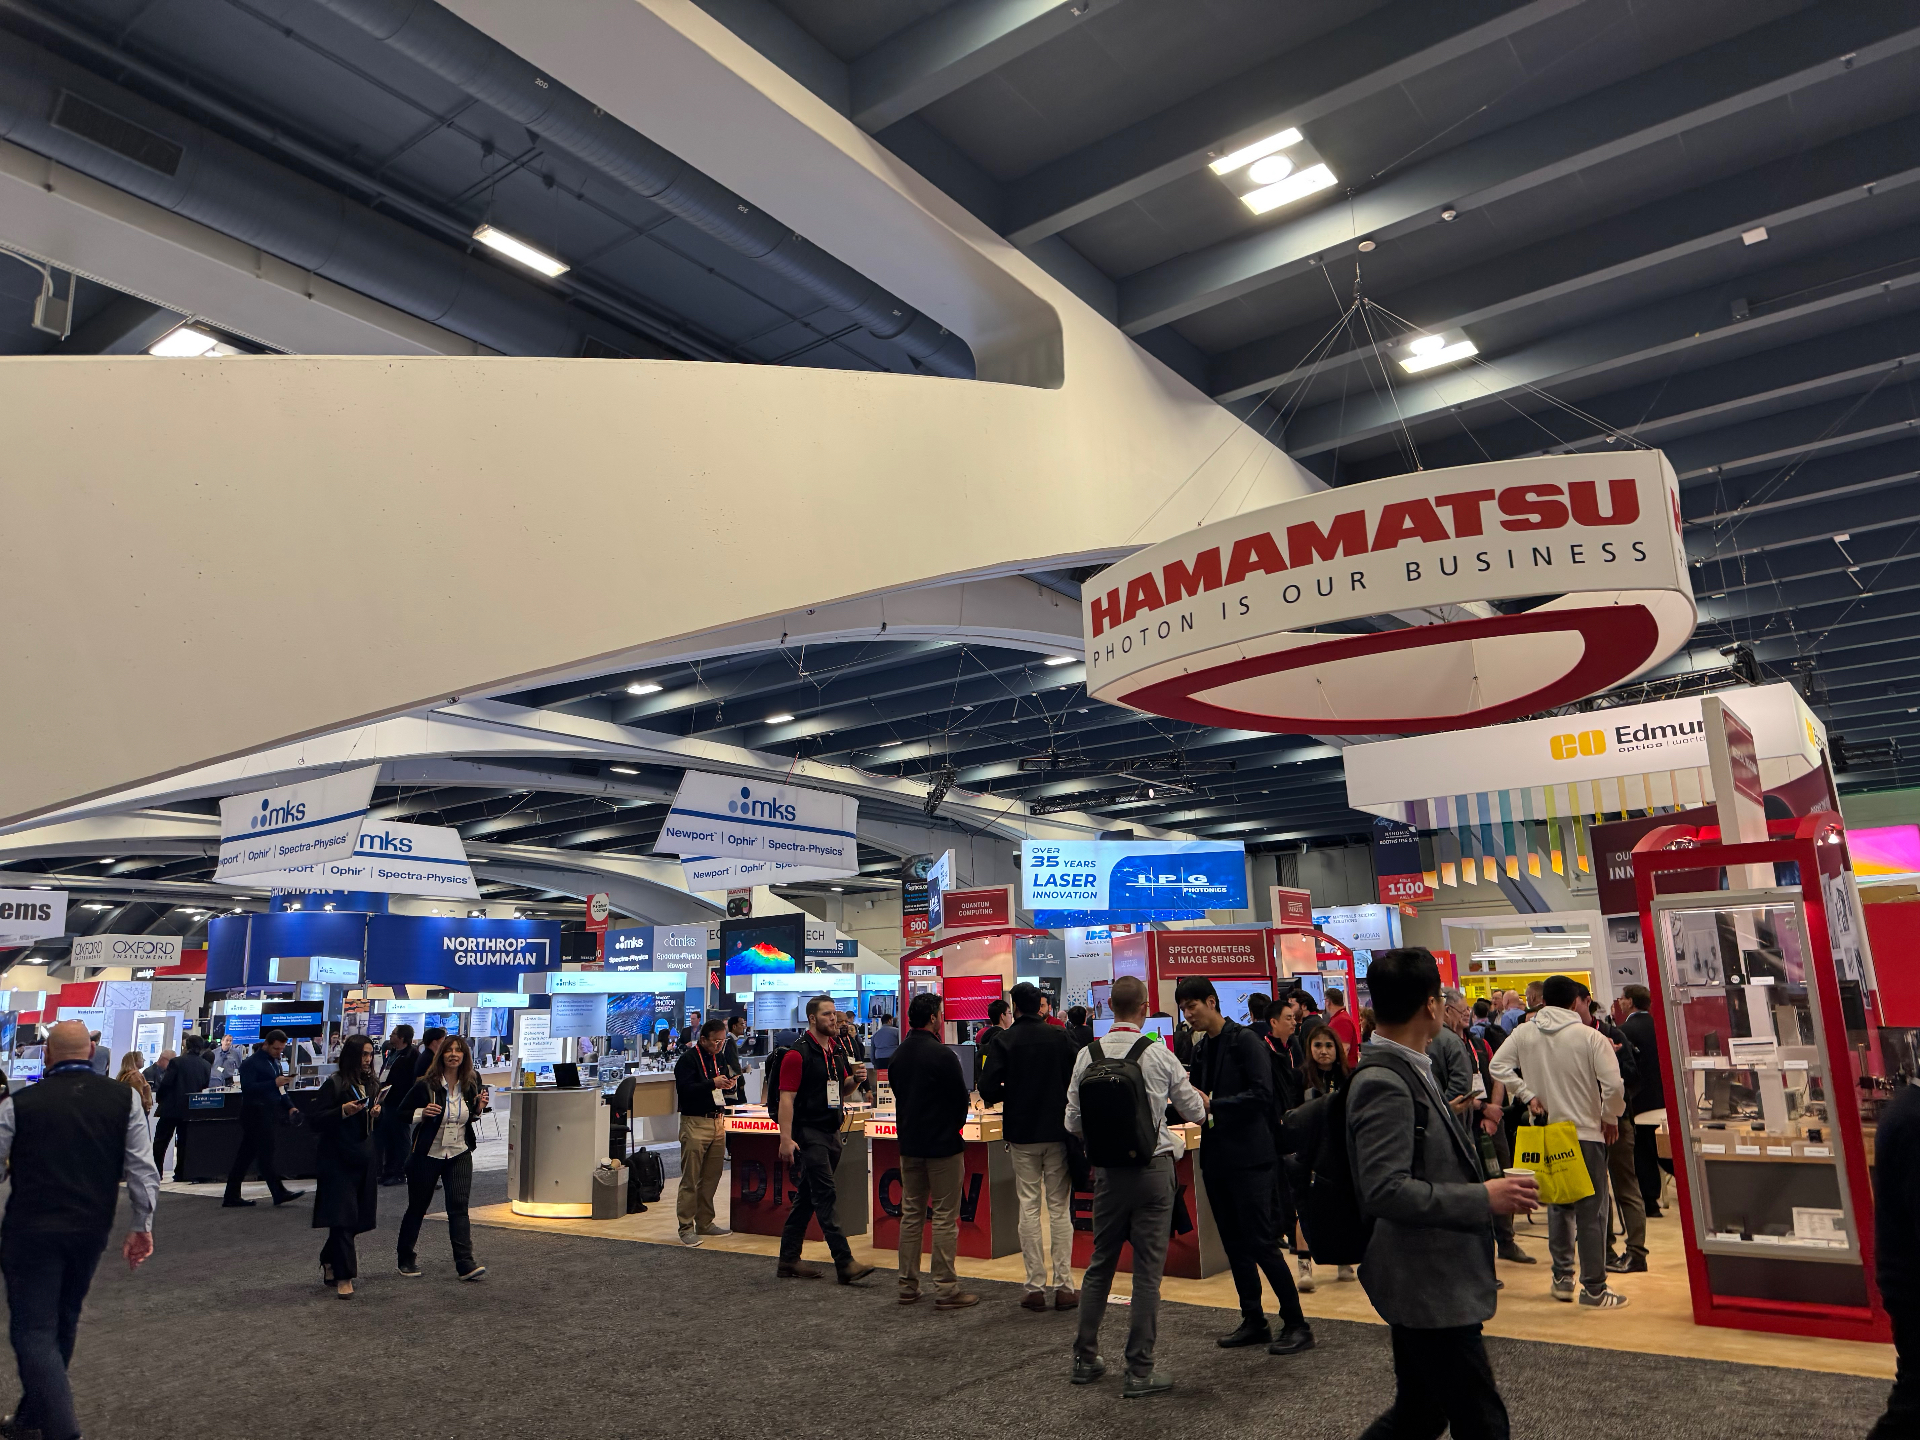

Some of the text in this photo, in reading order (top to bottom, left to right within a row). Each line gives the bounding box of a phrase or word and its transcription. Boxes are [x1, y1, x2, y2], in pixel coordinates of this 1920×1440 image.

[1092, 479, 1640, 638] HAMAMATSU
[1093, 612, 1195, 668] PHOTON
[1222, 595, 1251, 620] IS
[1282, 570, 1366, 604] OUR
[1406, 541, 1647, 583] BUSINESS
[1615, 720, 1704, 744] Edmu
[269, 800, 306, 827] mks
[752, 797, 796, 822] mks
[360, 831, 412, 852] mks
[666, 828, 714, 842] Newport
[768, 840, 842, 856] Spectra-Physics
[1030, 856, 1059, 868] 35
[1616, 852, 1632, 862] OU
[378, 869, 468, 884] Spectra-Physics
[1032, 874, 1096, 888] LASER
[1388, 882, 1424, 896] 1100
[910, 920, 926, 930] 900
[113, 940, 174, 954] OXFORD
[443, 936, 526, 952] NORTHROP
[1168, 946, 1251, 954] SPECTROMETERS
[454, 952, 536, 966] GRUMMAN
[1211, 955, 1256, 963] SENSORS
[732, 1120, 778, 1131] HAMAMA
